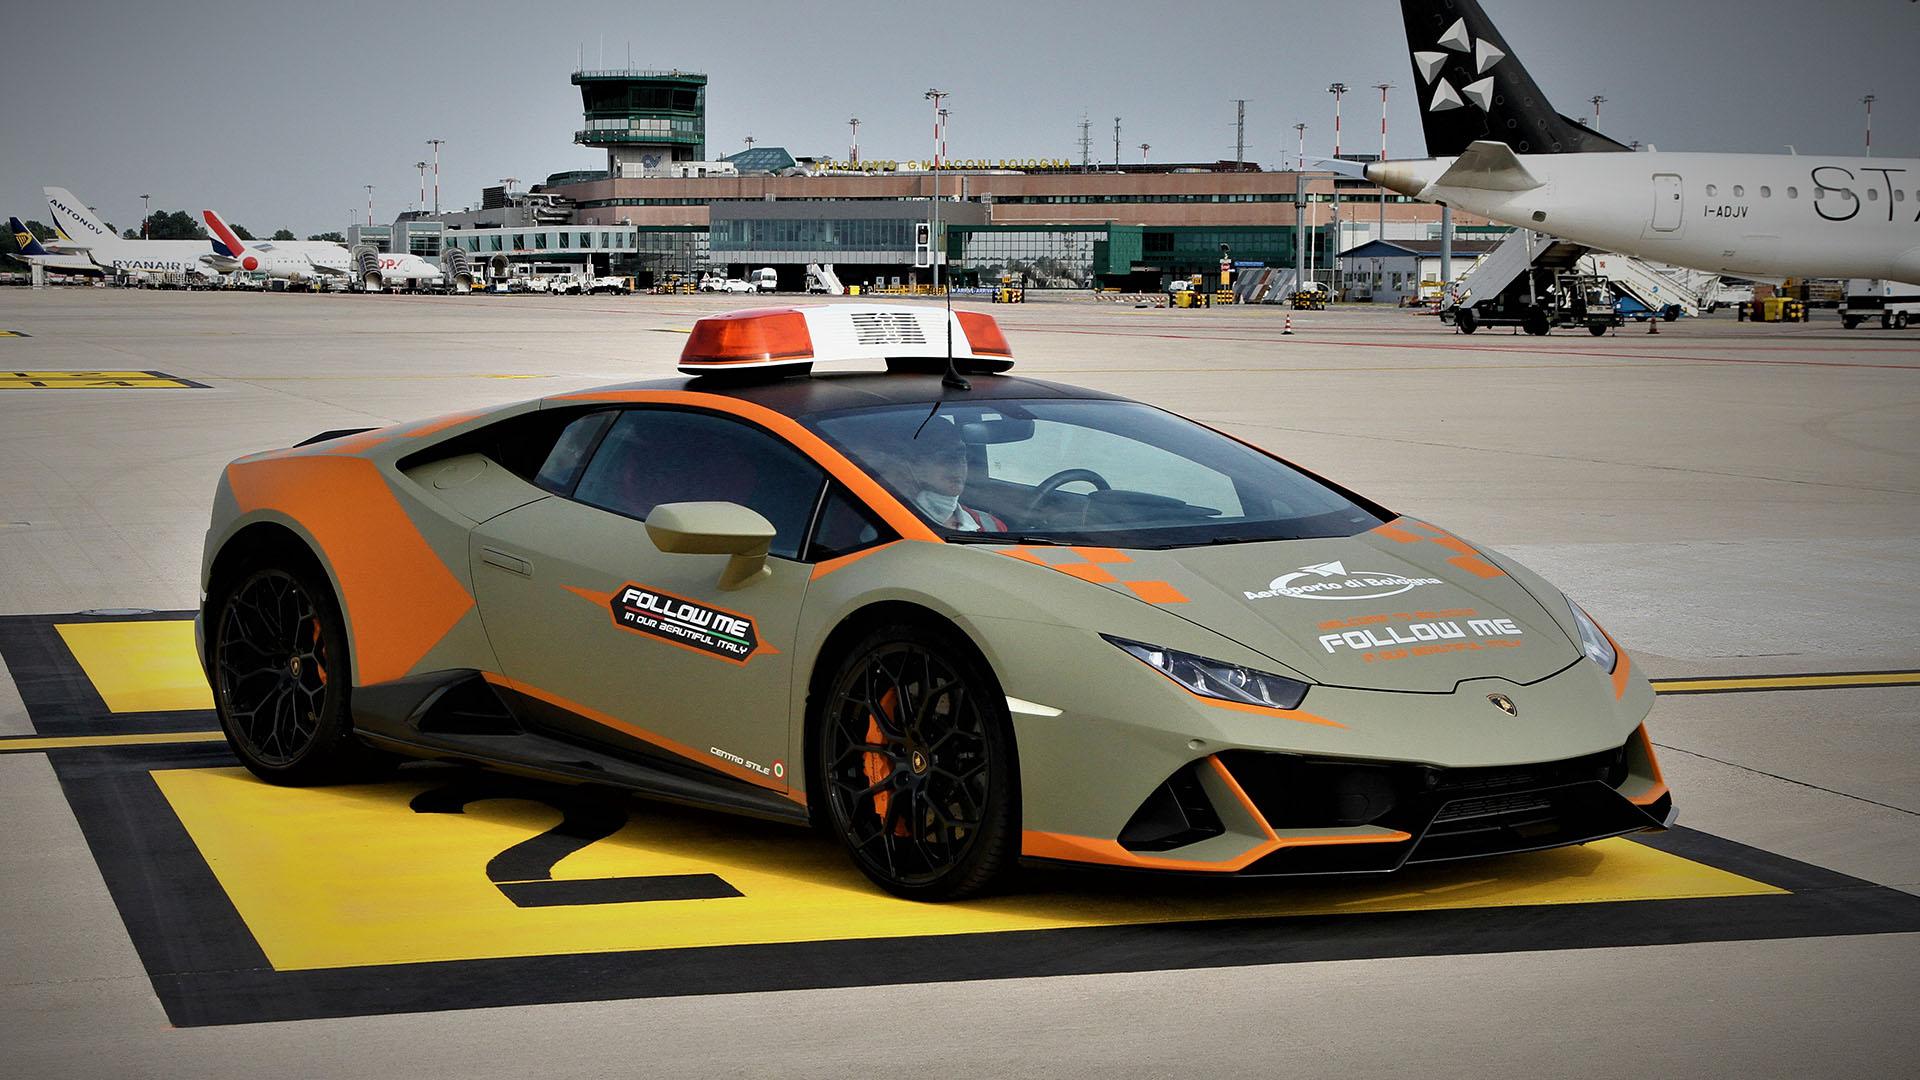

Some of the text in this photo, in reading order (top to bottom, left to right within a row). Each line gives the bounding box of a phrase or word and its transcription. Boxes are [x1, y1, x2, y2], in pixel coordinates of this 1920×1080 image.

[1000, 159, 1071, 169] BOLOGNA
[1704, 205, 1748, 218] I-ADJV
[1811, 166, 1920, 222] ST
[50, 199, 103, 235] ANTONOV
[112, 260, 181, 270] RYANAIR
[1243, 577, 1443, 600] Aeroporto di Bologna
[622, 588, 749, 638] FOLLOW ME
[624, 612, 748, 655] IN OUR BEAUTIFUL ITALY
[1318, 621, 1466, 654] FOLLOW
[1467, 618, 1523, 636] ME
[710, 746, 770, 776] CENTRO STILE
[409, 783, 747, 908] 2
